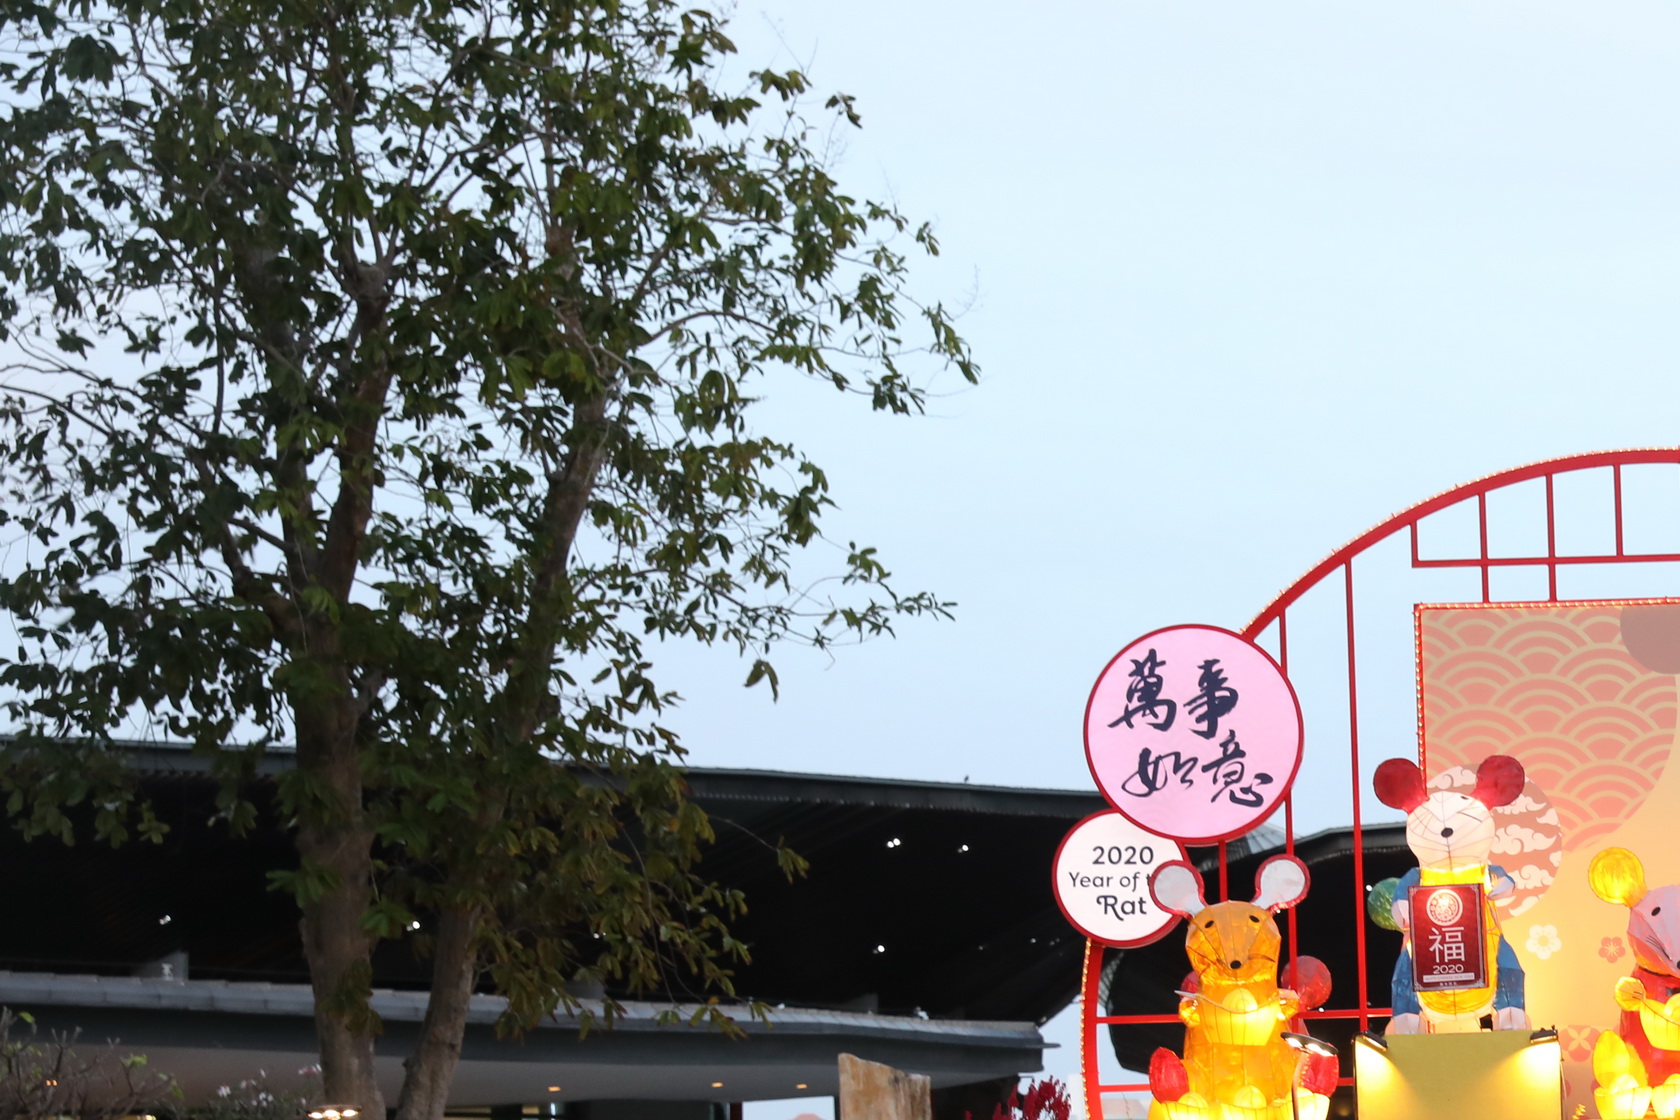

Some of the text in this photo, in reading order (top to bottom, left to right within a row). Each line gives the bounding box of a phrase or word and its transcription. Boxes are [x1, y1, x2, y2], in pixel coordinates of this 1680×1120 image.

[1092, 846, 1154, 865] 2020
[1068, 871, 1113, 888] Year
[1119, 871, 1141, 893] of
[1096, 895, 1147, 921] Rat
[1428, 927, 1465, 963] 福
[1433, 964, 1464, 974] 2020
